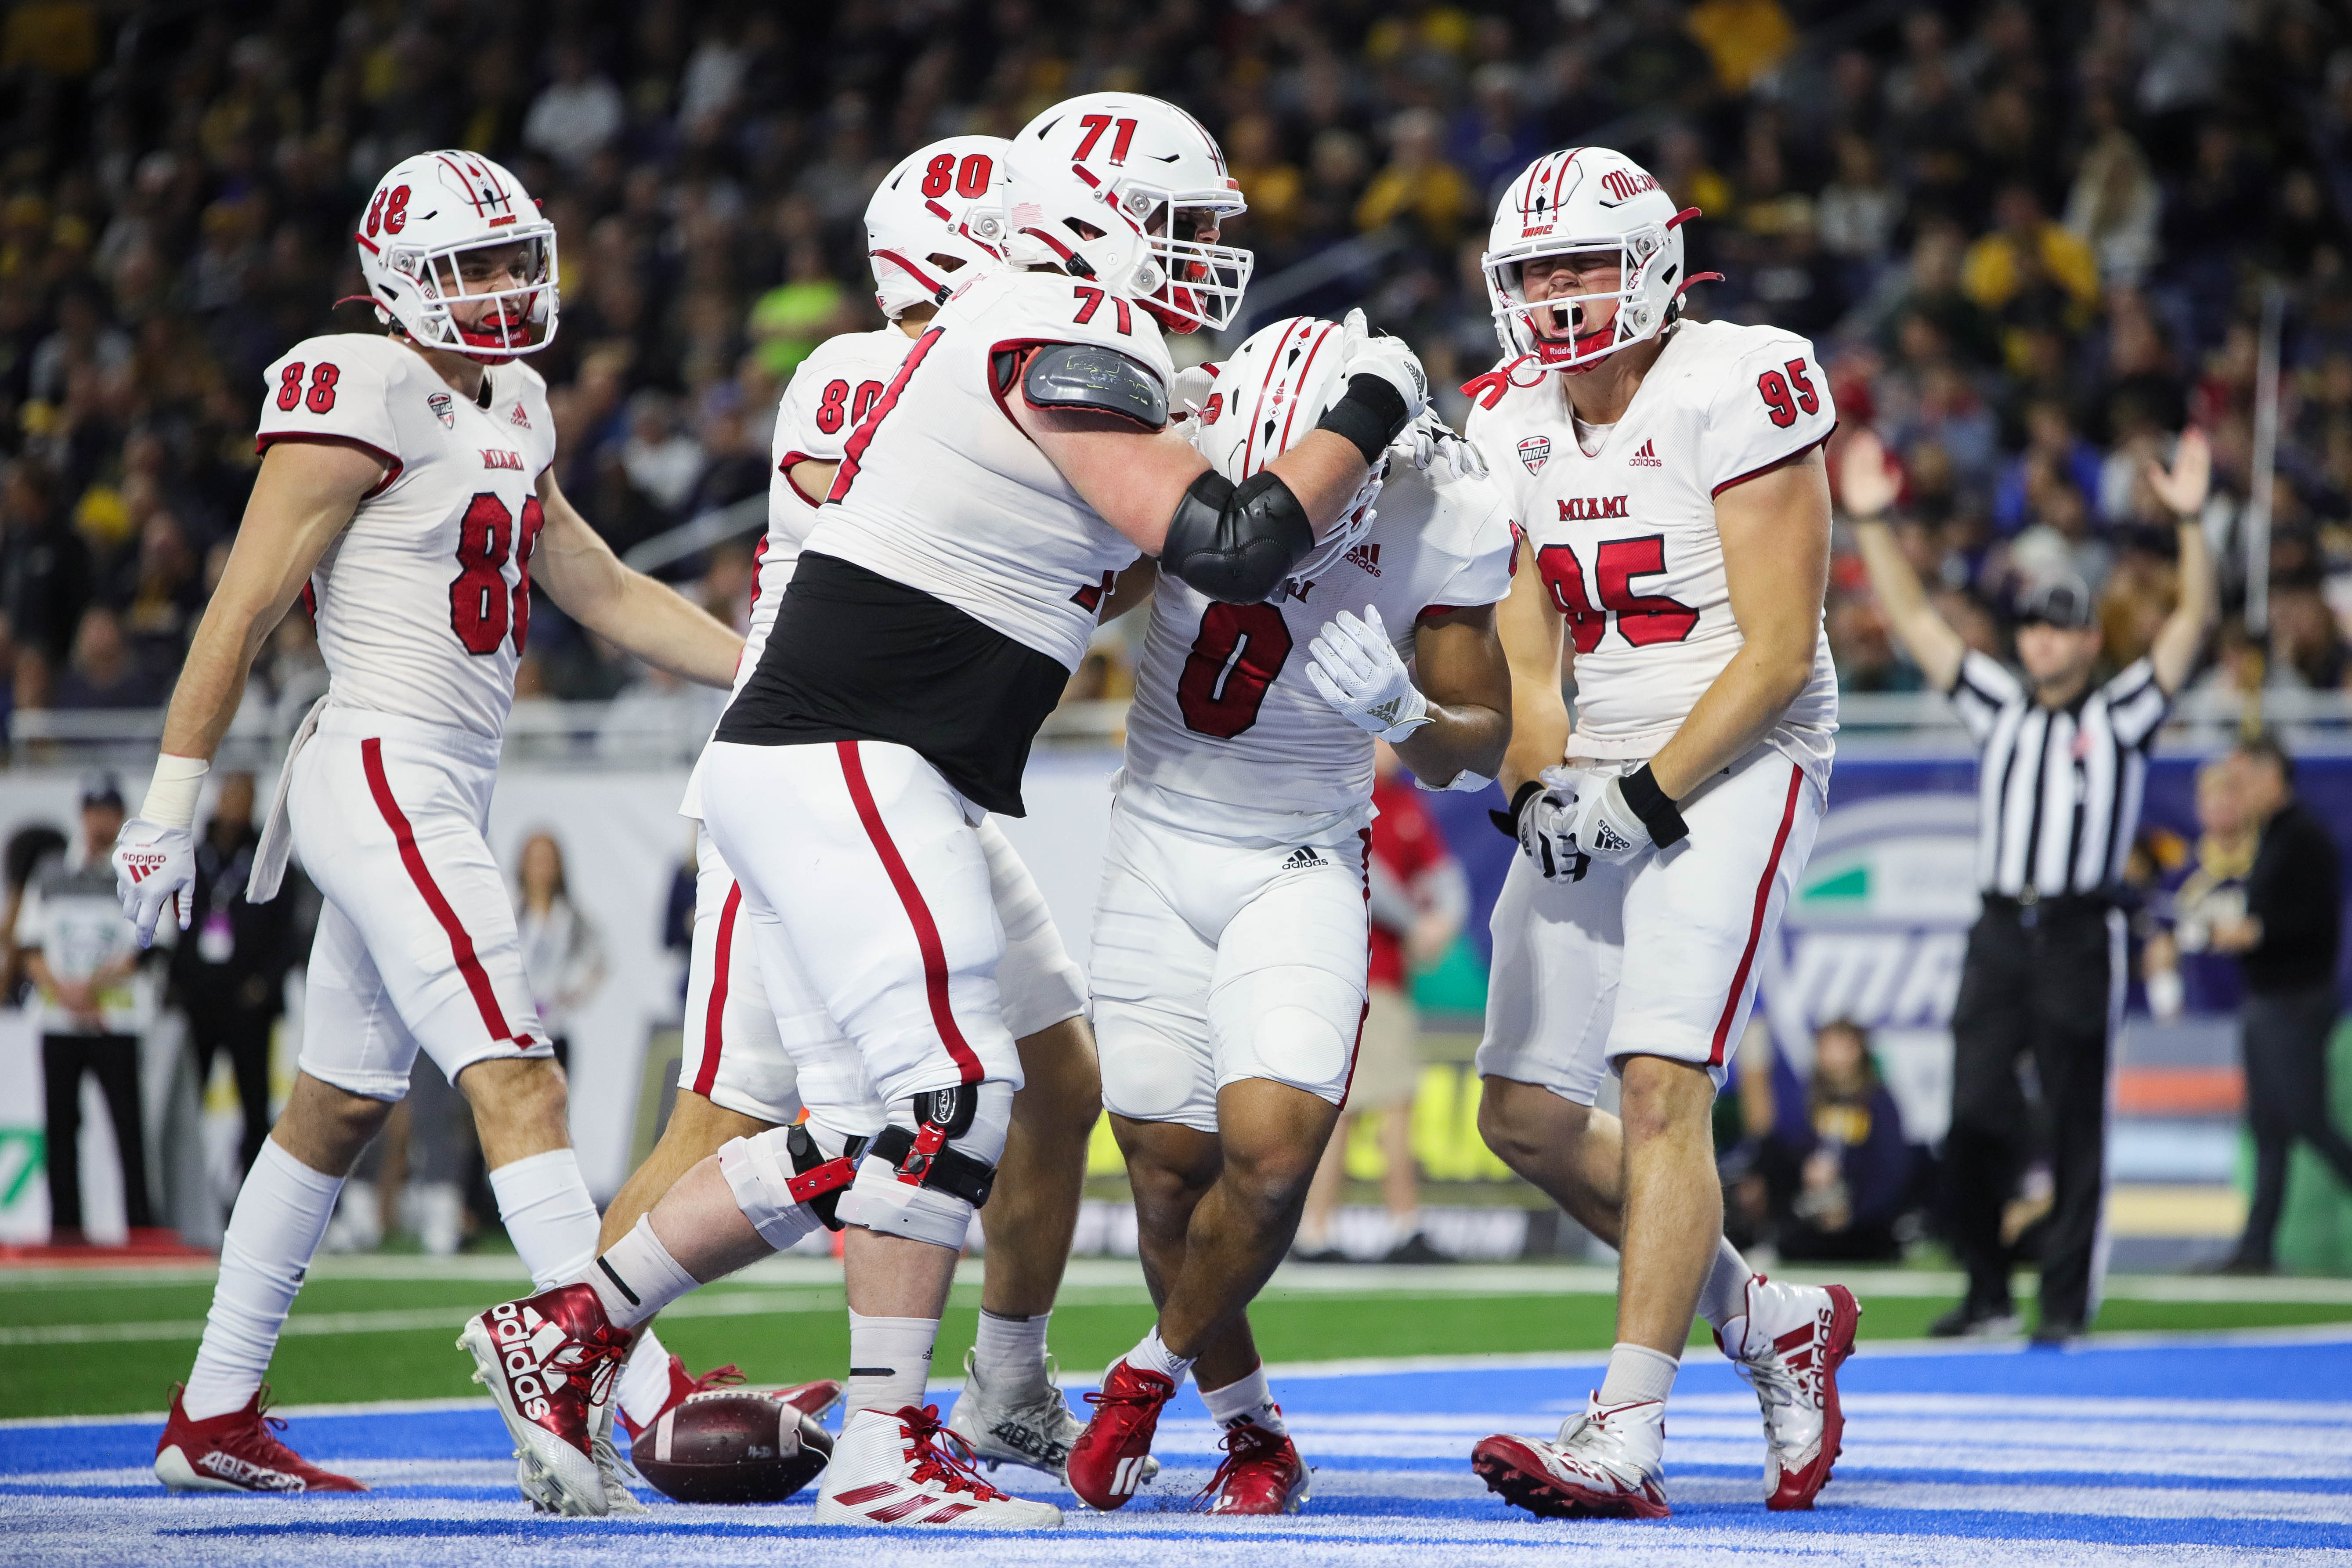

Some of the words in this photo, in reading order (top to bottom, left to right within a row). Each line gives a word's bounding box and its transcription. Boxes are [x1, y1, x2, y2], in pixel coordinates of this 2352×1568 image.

[1071, 114, 1138, 167] 71
[921, 153, 993, 199] 80
[366, 185, 411, 238] 88
[1521, 224, 1554, 238] MAC
[1073, 285, 1132, 336] 71
[277, 362, 340, 414] 88
[1757, 357, 1819, 429] 95
[1520, 446, 1550, 461] MAC
[1629, 456, 1662, 467] adidas
[1557, 495, 1629, 522] MIAMI
[1536, 534, 1699, 654] 95
[1177, 599, 1293, 740] 0
[1598, 819, 1631, 849] adidas
[123, 853, 166, 865] adidas
[1282, 858, 1329, 870] adidas
[492, 1303, 551, 1421] adidas
